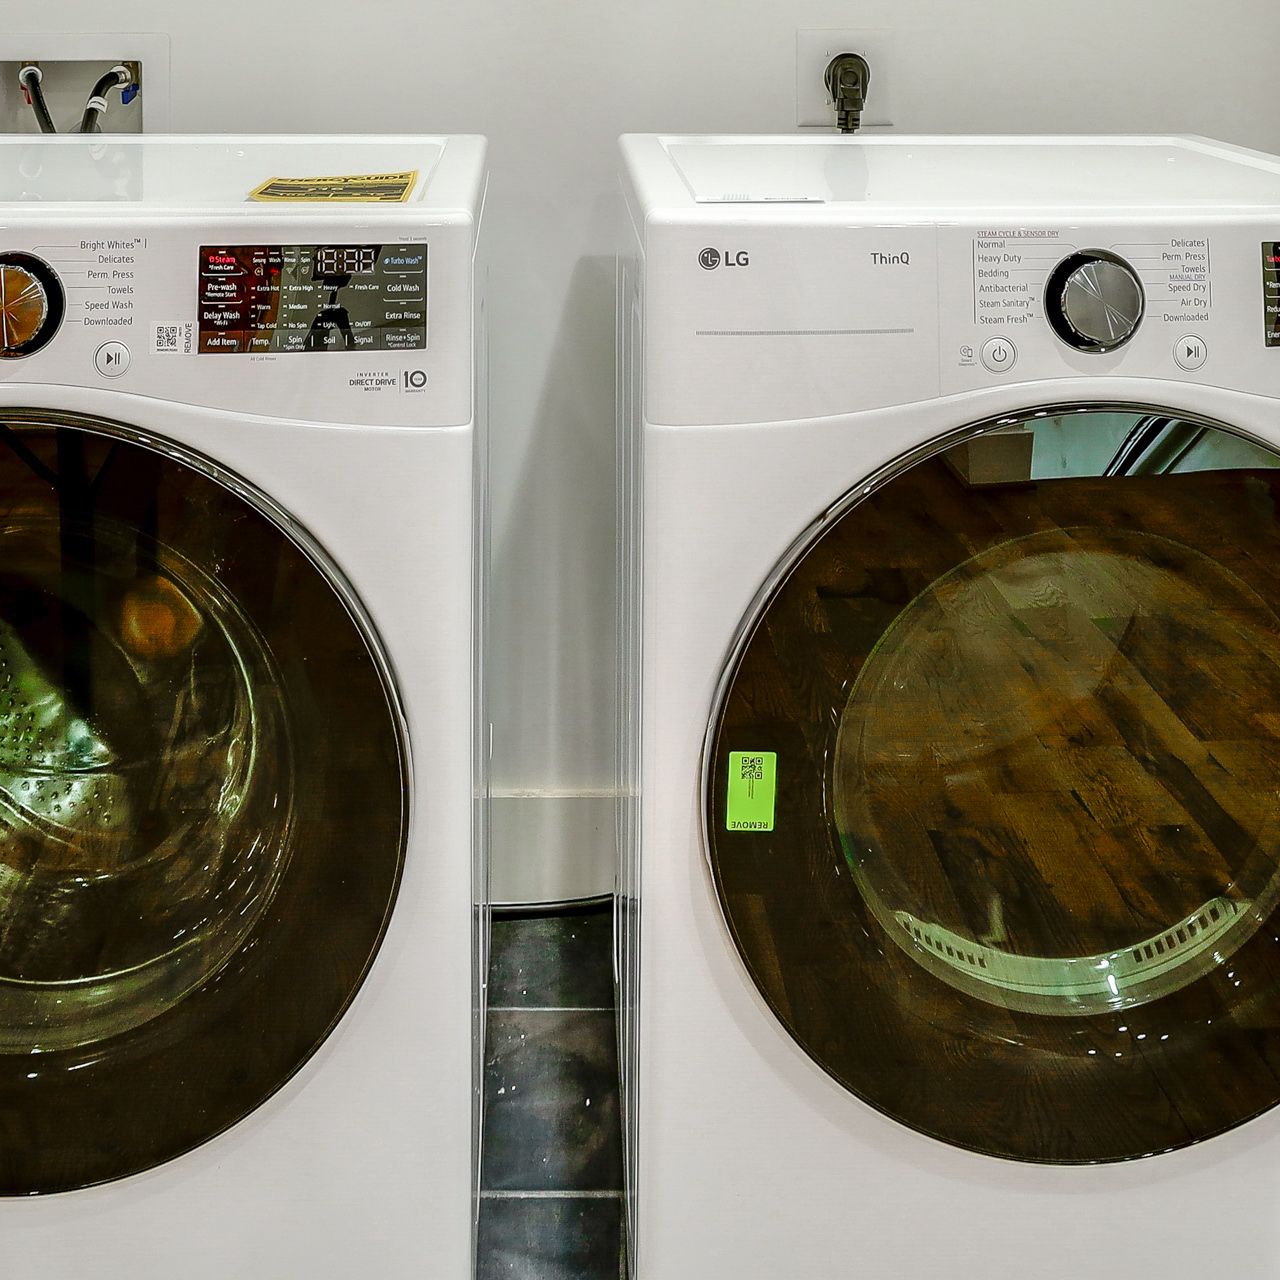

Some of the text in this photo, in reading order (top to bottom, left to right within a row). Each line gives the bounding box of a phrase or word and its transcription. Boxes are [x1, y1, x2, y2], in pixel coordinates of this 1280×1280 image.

[80, 240, 105, 251] Bright
[977, 240, 1006, 249] Normal
[1171, 239, 1205, 248] Delicates
[98, 255, 134, 264] Delicates
[725, 251, 750, 267] LG
[870, 252, 910, 265] ThinQ
[978, 253, 1022, 264] Heavy Duty
[1185, 252, 1206, 260] Press
[1181, 264, 1206, 273] Towels
[112, 270, 134, 279] Press
[978, 269, 1009, 279] Bedding
[107, 285, 134, 294] Towels
[207, 283, 237, 291] Pre-wash
[979, 283, 1028, 293] Antibacterial
[1168, 283, 1207, 293] Speed Dry
[84, 301, 133, 311] Speed Wash
[979, 299, 1000, 308] Steam
[1180, 298, 1208, 309] Air Dry
[203, 311, 240, 321] Delay Wash
[980, 315, 1005, 324] Steam
[1163, 313, 1209, 322] Downloaded
[83, 316, 133, 326] Downloaded
[184, 323, 193, 353] REMOVE
[207, 338, 237, 346] Add Item
[252, 337, 271, 346] Temp.
[288, 336, 303, 344] Spin
[323, 336, 336, 344] Soil
[354, 336, 374, 345] Signal
[404, 370, 427, 388] 10
[731, 821, 769, 829] REMOVE
